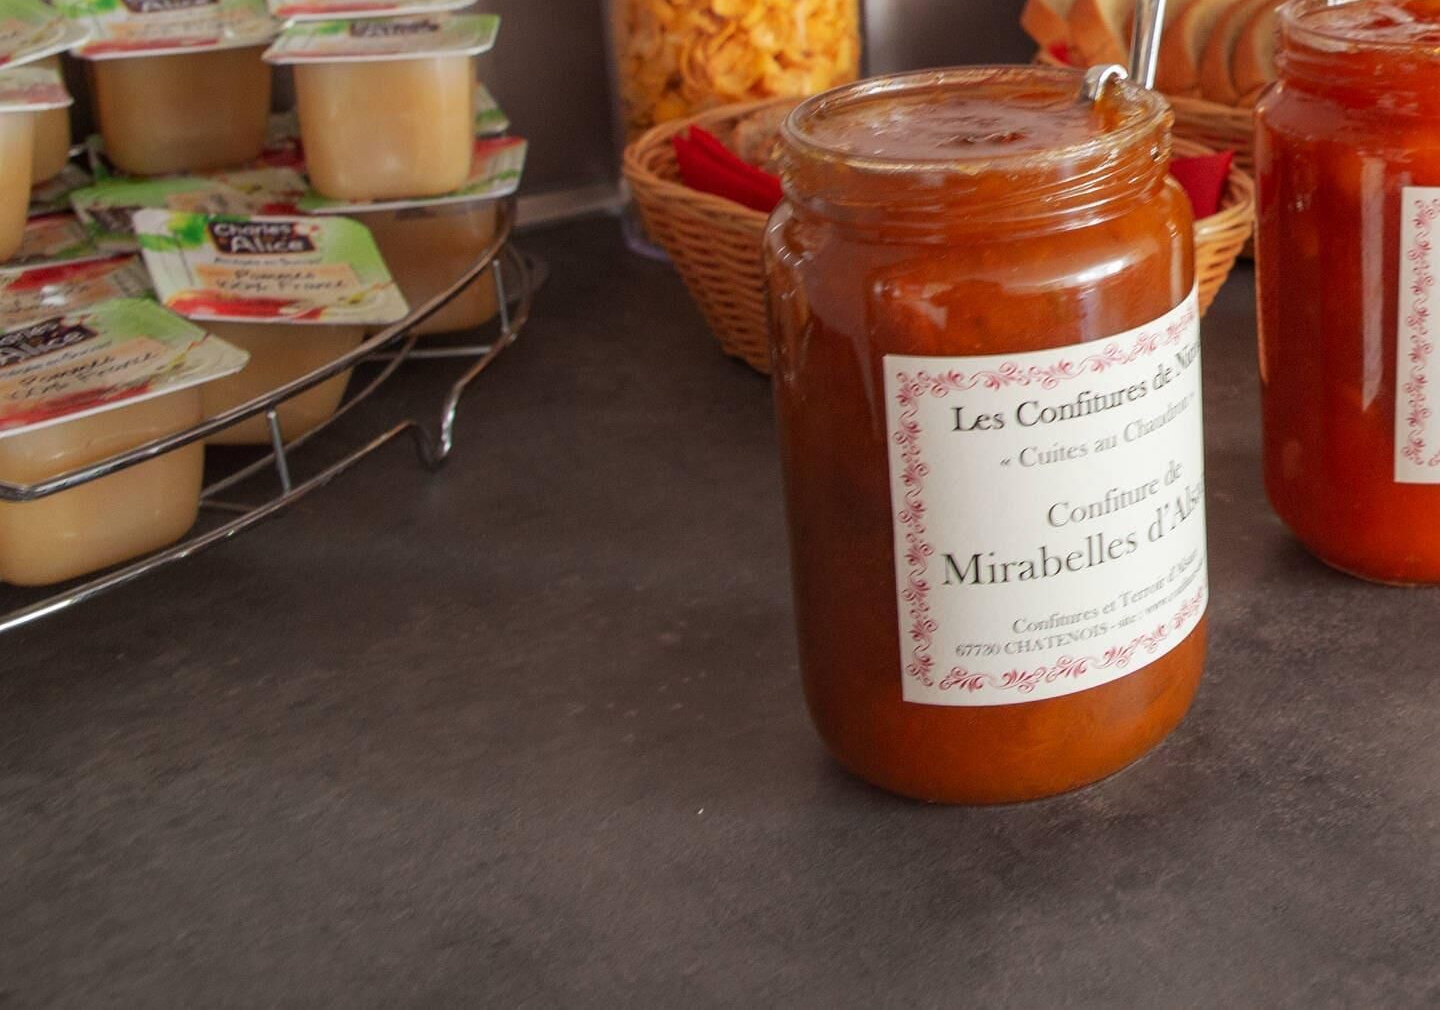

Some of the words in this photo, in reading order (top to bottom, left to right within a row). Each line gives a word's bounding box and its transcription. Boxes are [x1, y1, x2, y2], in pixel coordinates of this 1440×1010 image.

[213, 221, 292, 238] Charles
[230, 235, 306, 253] Alice
[951, 405, 1006, 432] Les
[1016, 379, 1147, 427] Confitures
[1152, 362, 1173, 391] de
[1019, 442, 1089, 468] Cuites
[1094, 434, 1118, 454] au
[1047, 478, 1159, 528] Confiture
[1164, 459, 1183, 487] de
[941, 531, 1138, 586] Mirabelles
[1012, 607, 1099, 635] Confitures
[1102, 600, 1116, 615] et
[1004, 622, 1108, 655] CHATENOIS
